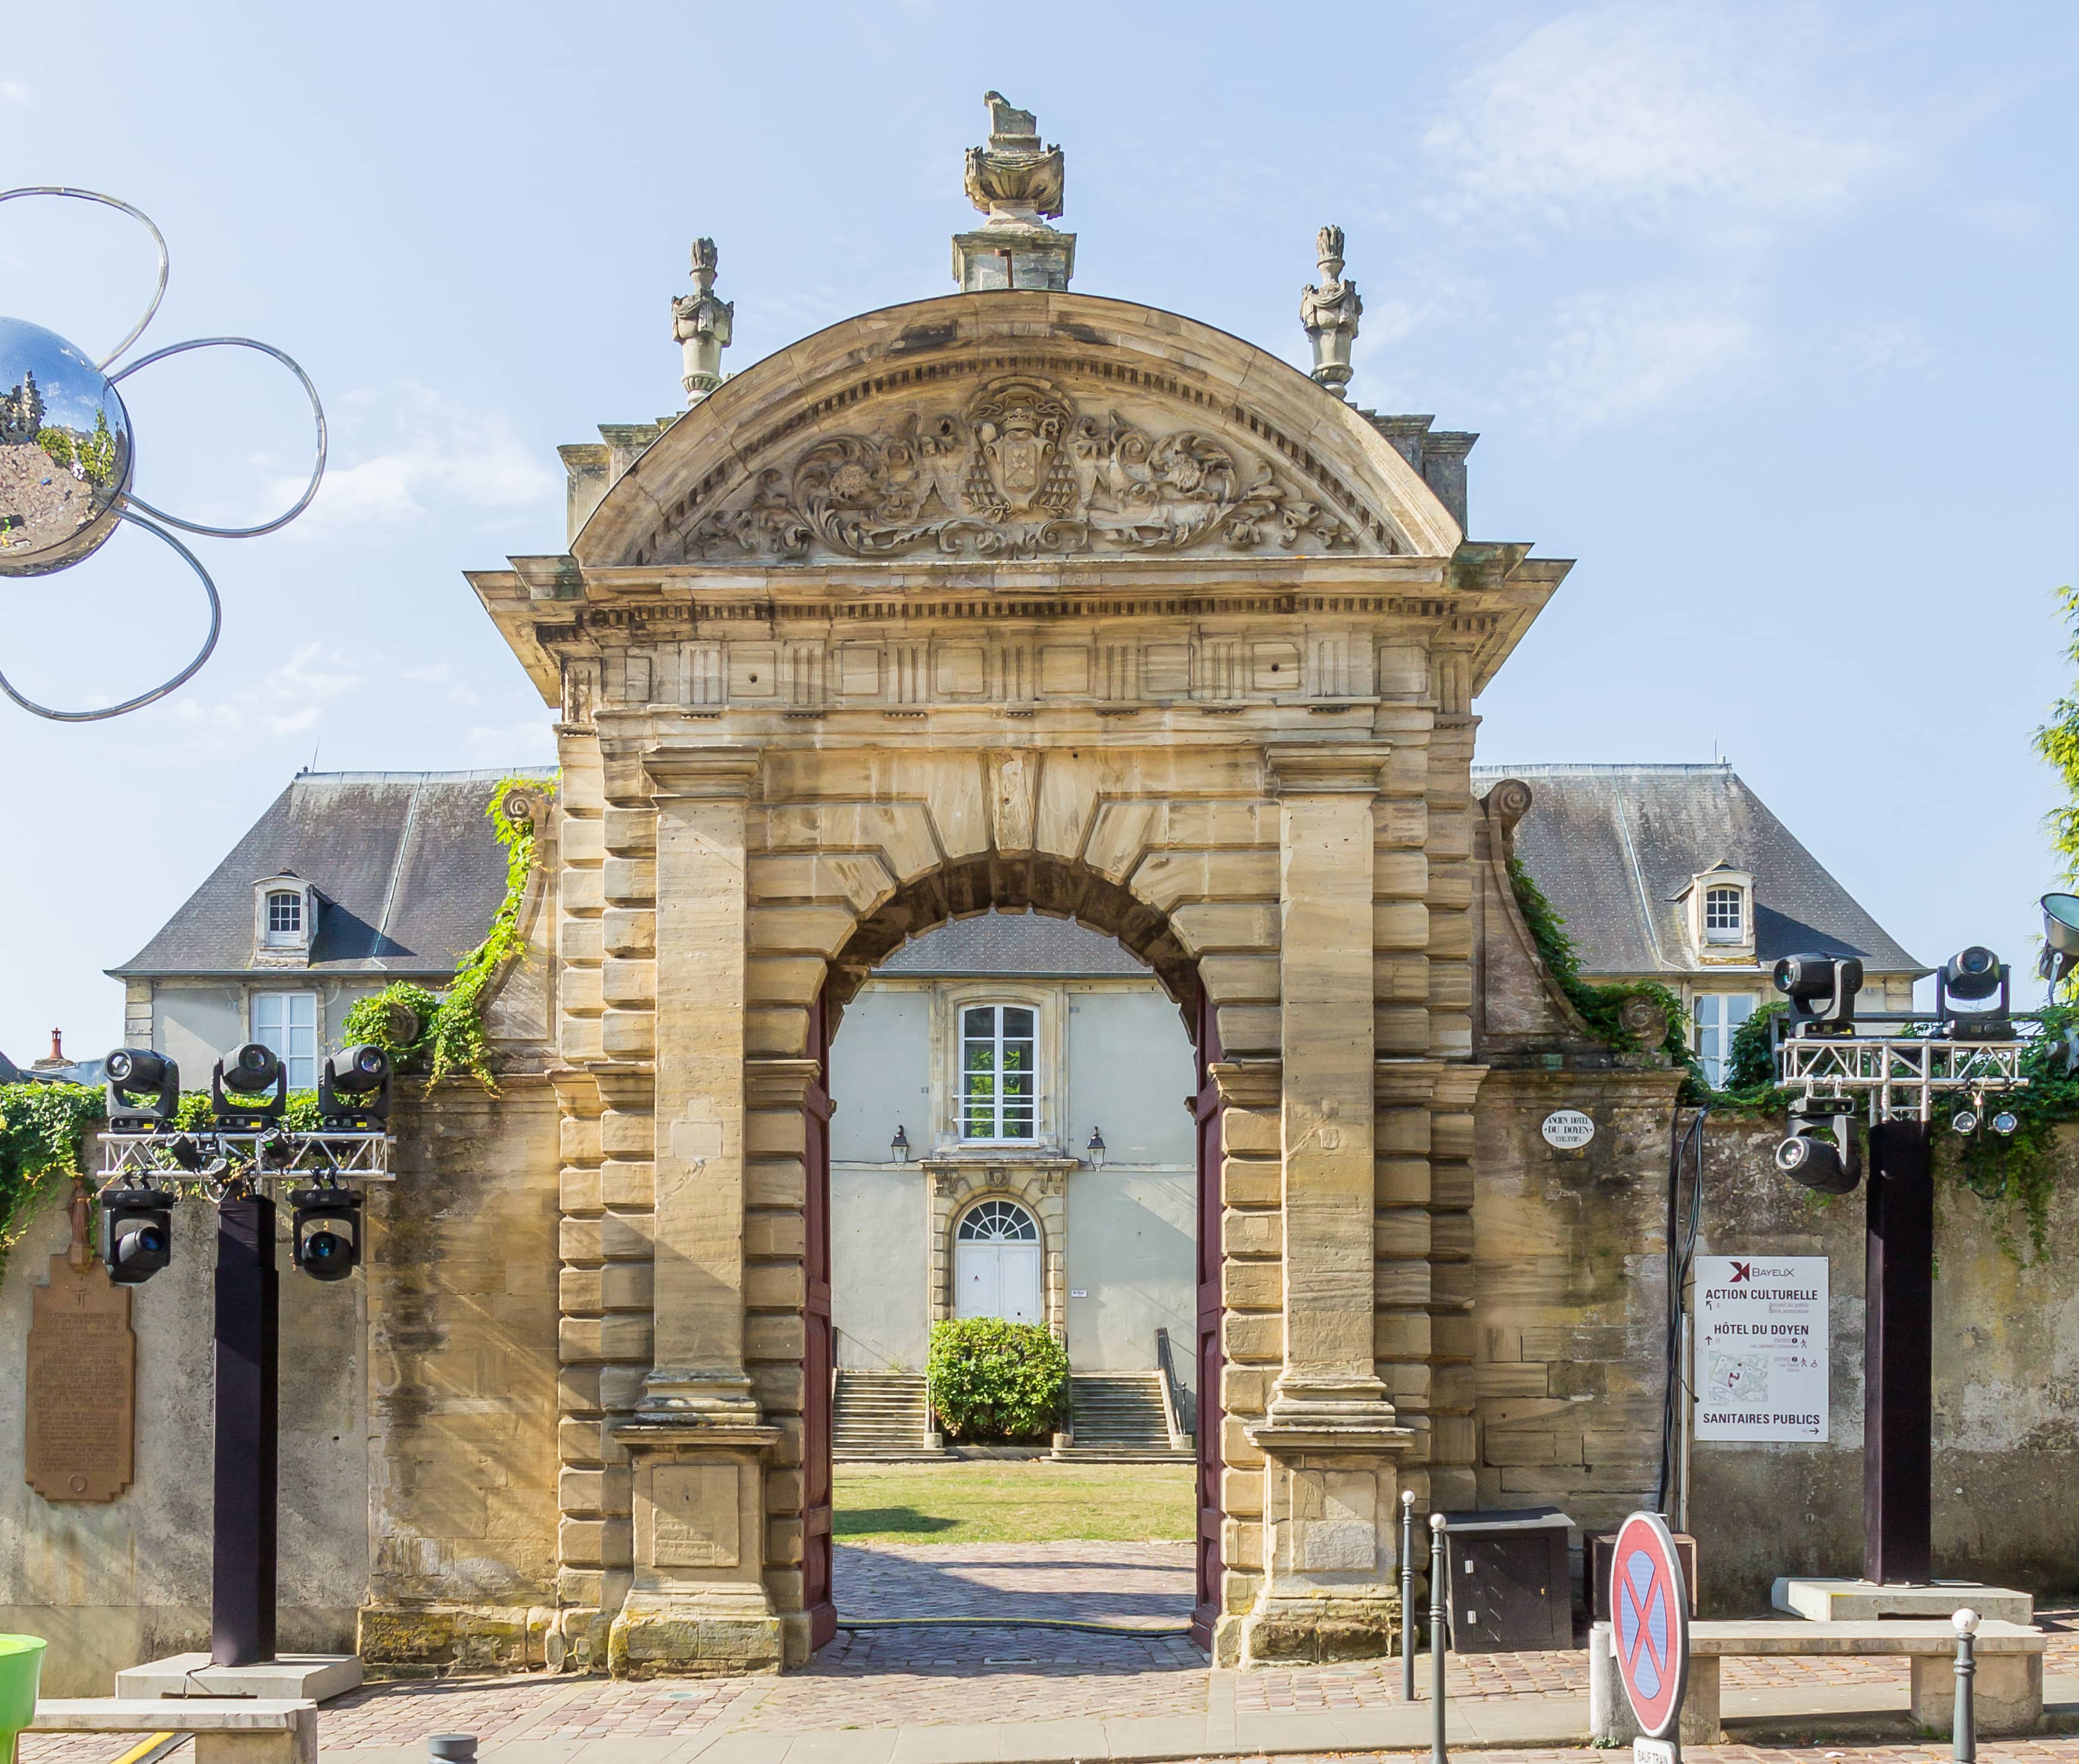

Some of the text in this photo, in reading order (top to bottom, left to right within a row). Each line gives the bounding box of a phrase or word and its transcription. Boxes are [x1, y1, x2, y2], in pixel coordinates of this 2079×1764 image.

[1564, 1126, 1589, 1134] DOYEN
[1705, 1289, 1818, 1300] ACTION CULTURELLE
[1714, 1321, 1810, 1335] HÔTEL DU DOYEN
[1703, 1413, 1820, 1425] SANITAIRES PUBLICS
[1637, 1750, 1651, 1764] SAUF
